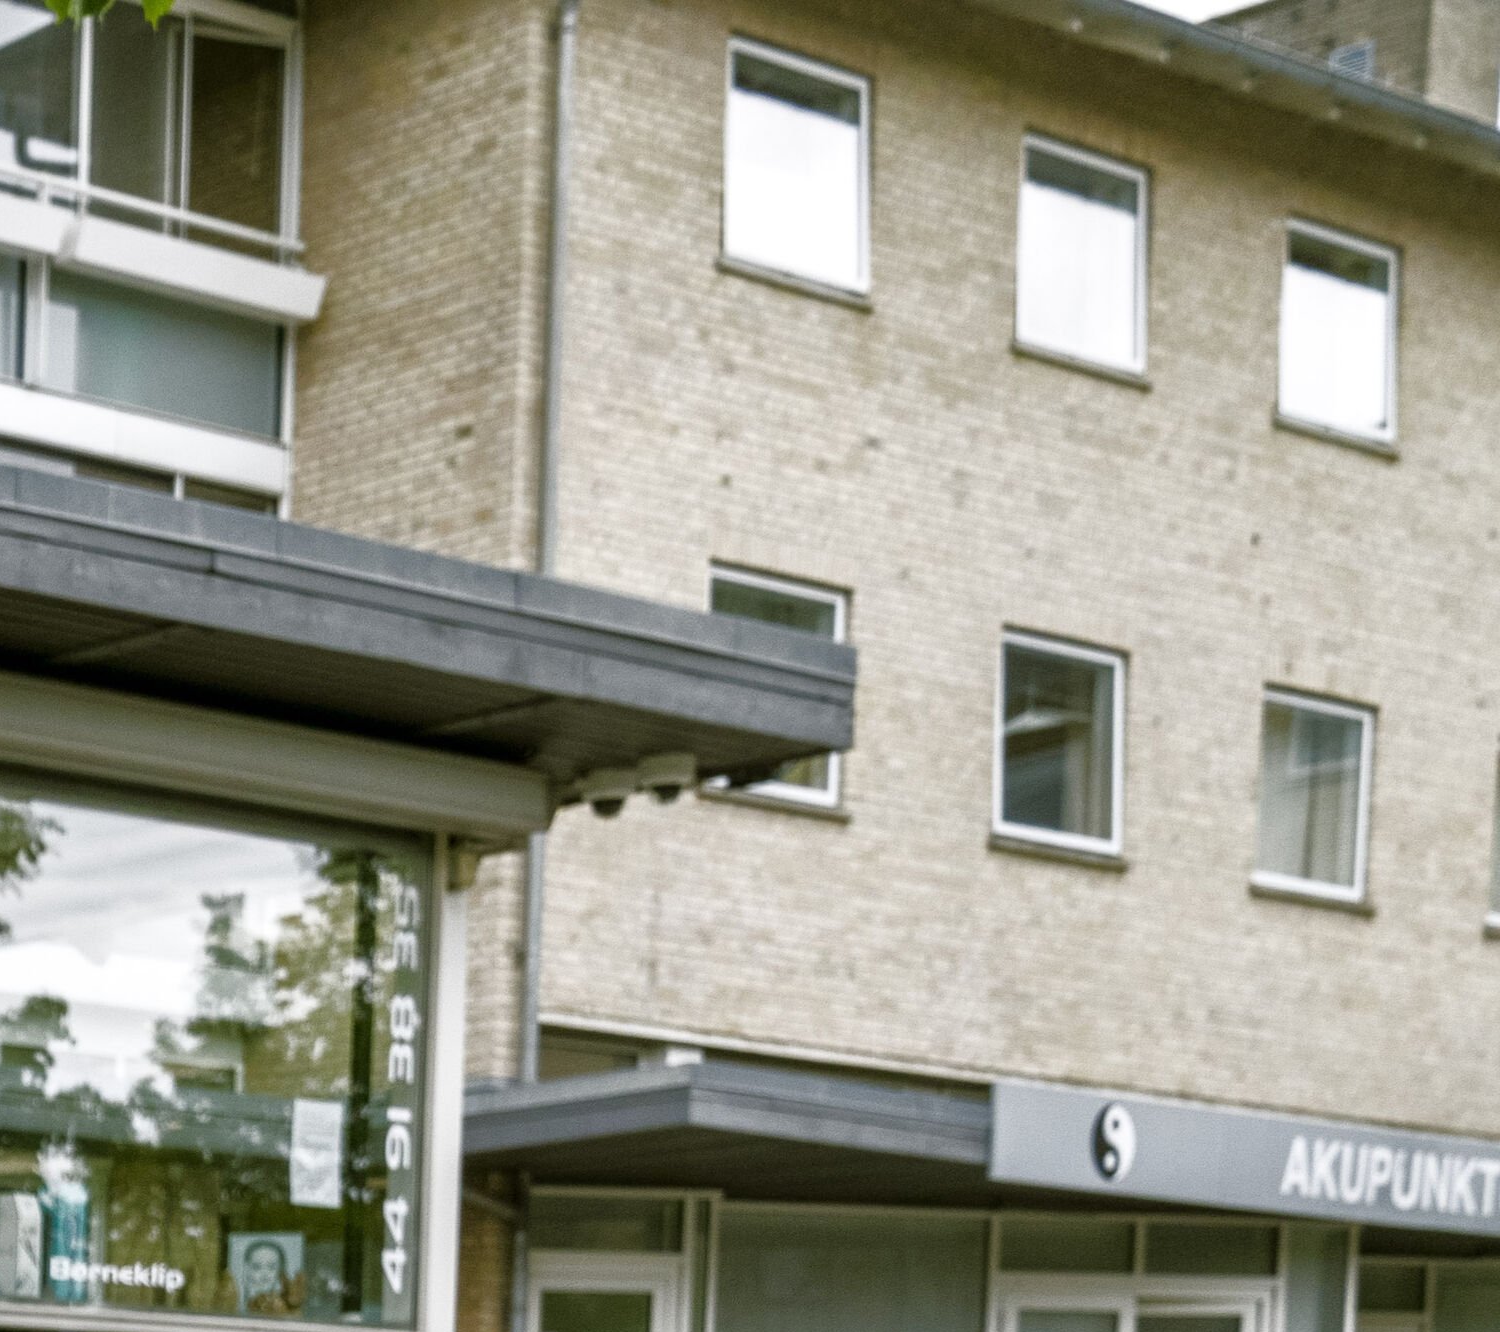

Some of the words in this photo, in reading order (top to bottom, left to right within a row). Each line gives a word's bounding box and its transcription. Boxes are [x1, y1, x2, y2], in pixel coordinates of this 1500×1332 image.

[388, 994, 417, 1085] 38
[1279, 1135, 1500, 1217] AKUPUNKT
[381, 1196, 409, 1294] 44
